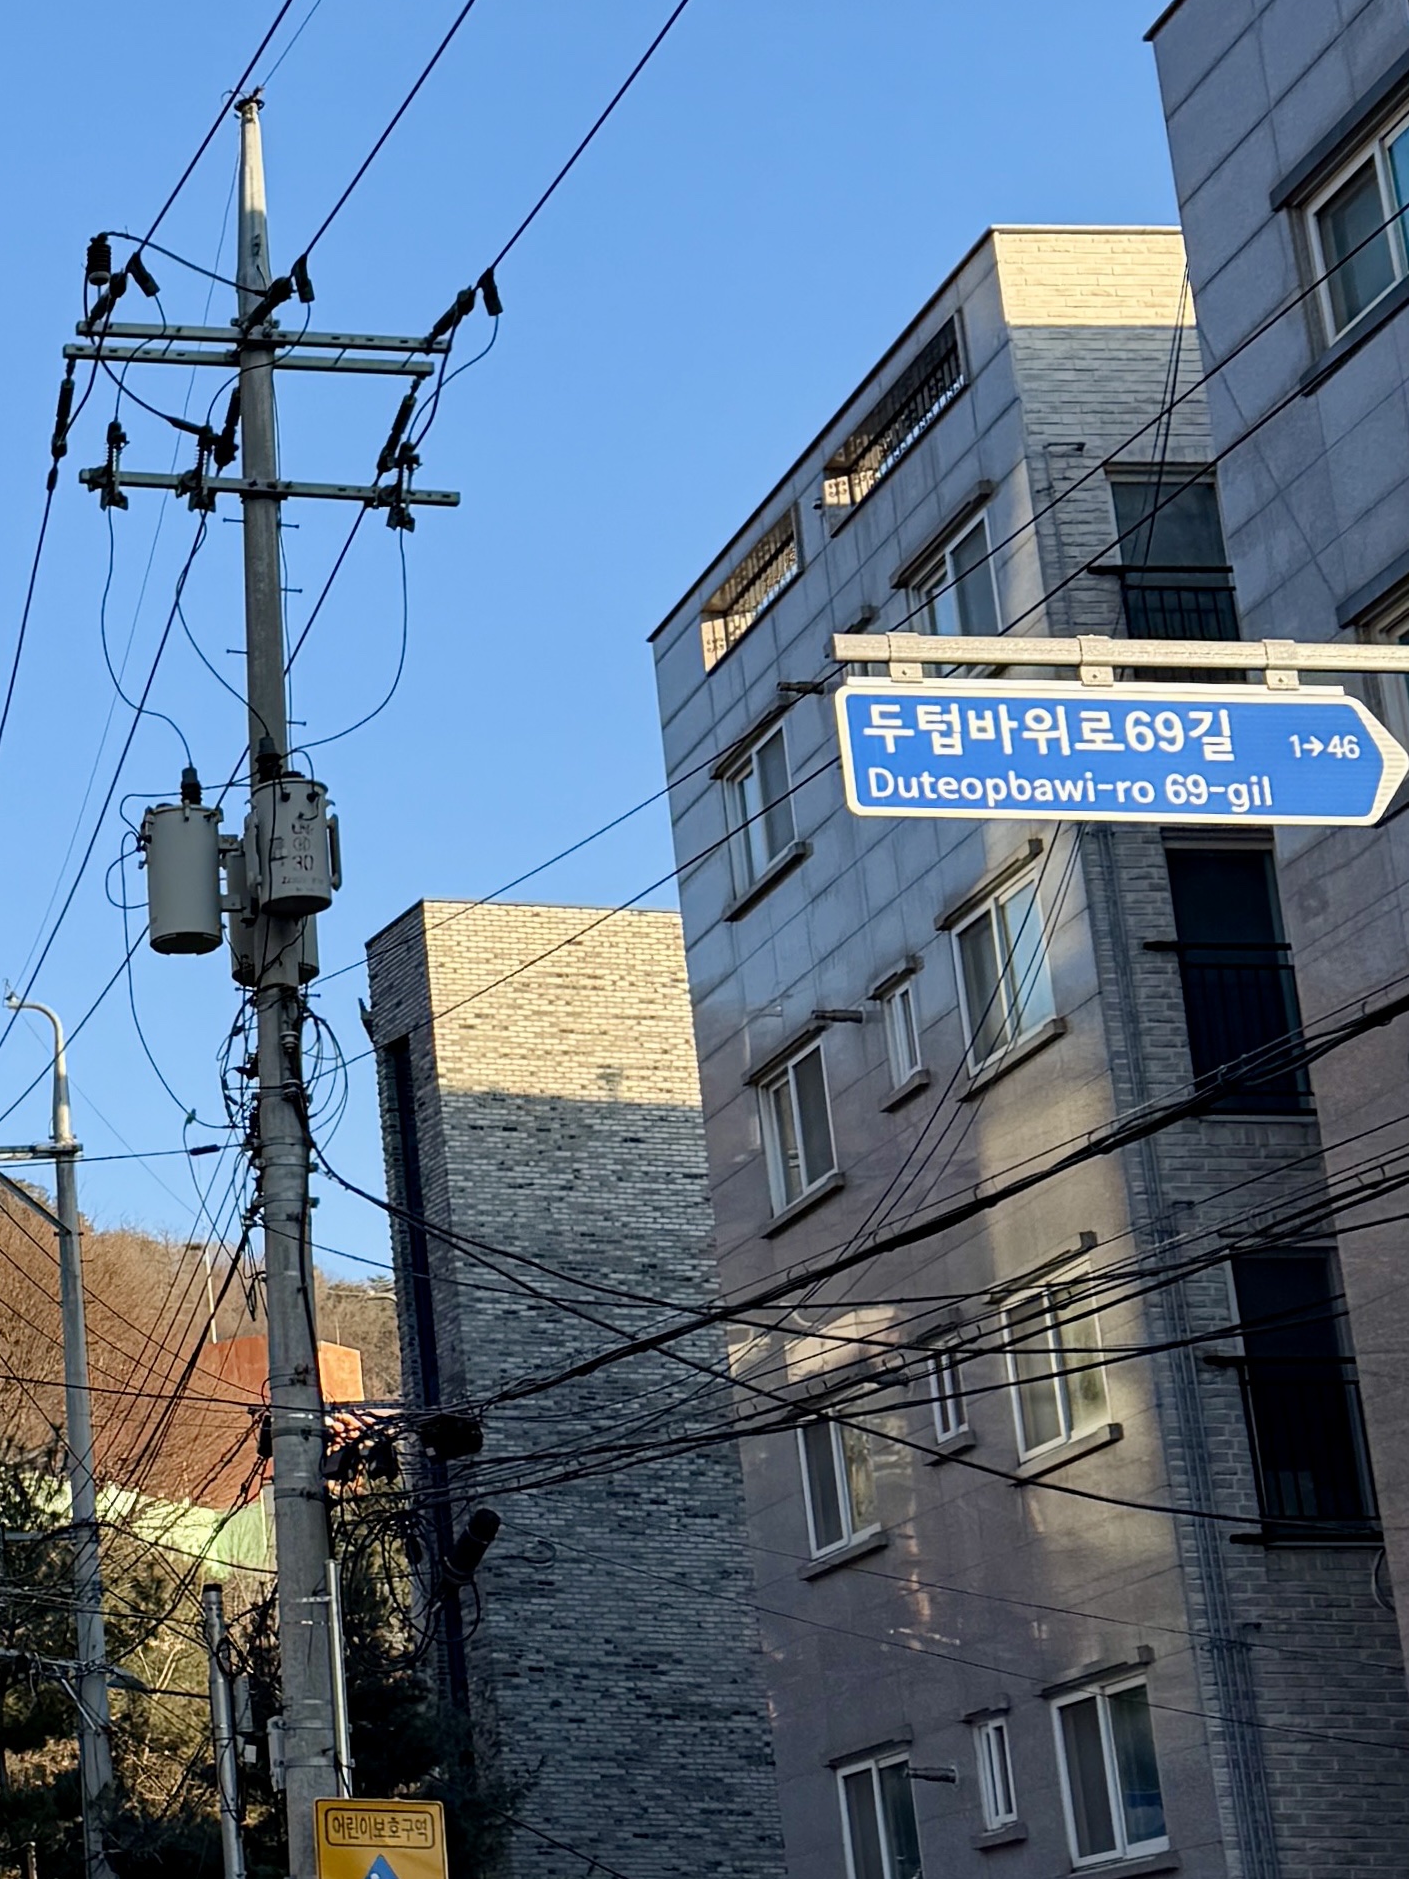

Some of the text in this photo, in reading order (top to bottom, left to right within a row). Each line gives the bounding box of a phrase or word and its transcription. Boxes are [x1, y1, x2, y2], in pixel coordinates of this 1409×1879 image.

[863, 702, 1235, 762] 두텁바위로69길
[1327, 735, 1361, 760] 46
[868, 766, 1272, 813] Duteopbawi-ro 69-gil
[332, 1814, 428, 1843] 어린이보호구역
